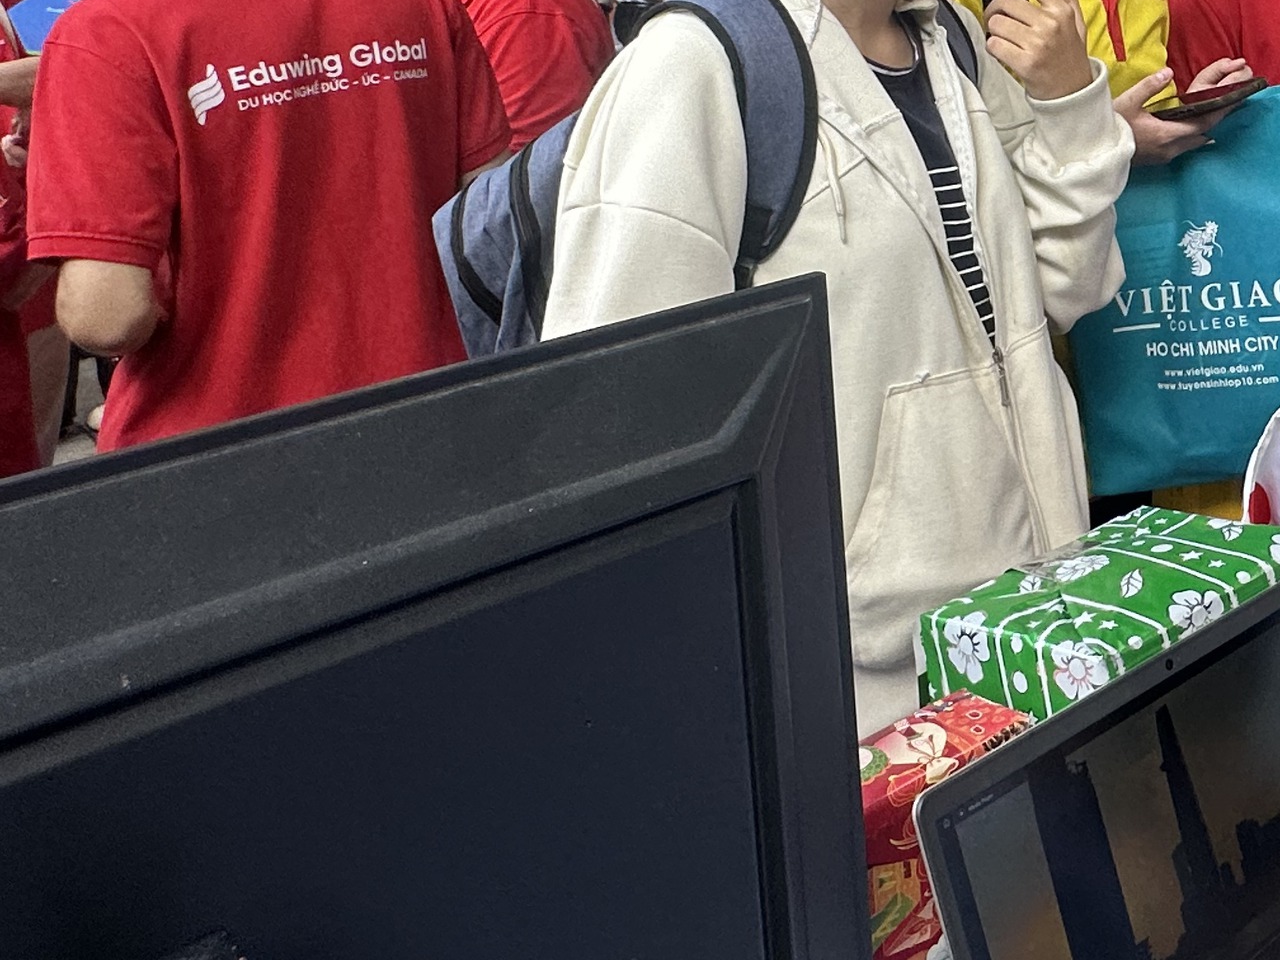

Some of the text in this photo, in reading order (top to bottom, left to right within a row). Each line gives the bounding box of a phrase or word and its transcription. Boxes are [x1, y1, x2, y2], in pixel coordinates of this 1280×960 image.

[227, 38, 427, 91] Eduwing Global
[238, 97, 260, 111] DU
[263, 89, 293, 106] HỌC
[321, 76, 349, 93] ĐỨC
[394, 68, 428, 82] CANADA
[1114, 279, 1193, 320] VIỆT
[1170, 315, 1249, 332] COLLEGE
[1146, 335, 1280, 357] HO CHI MINH CITY
[1164, 363, 1265, 377] www.vietgiao.edu.vn
